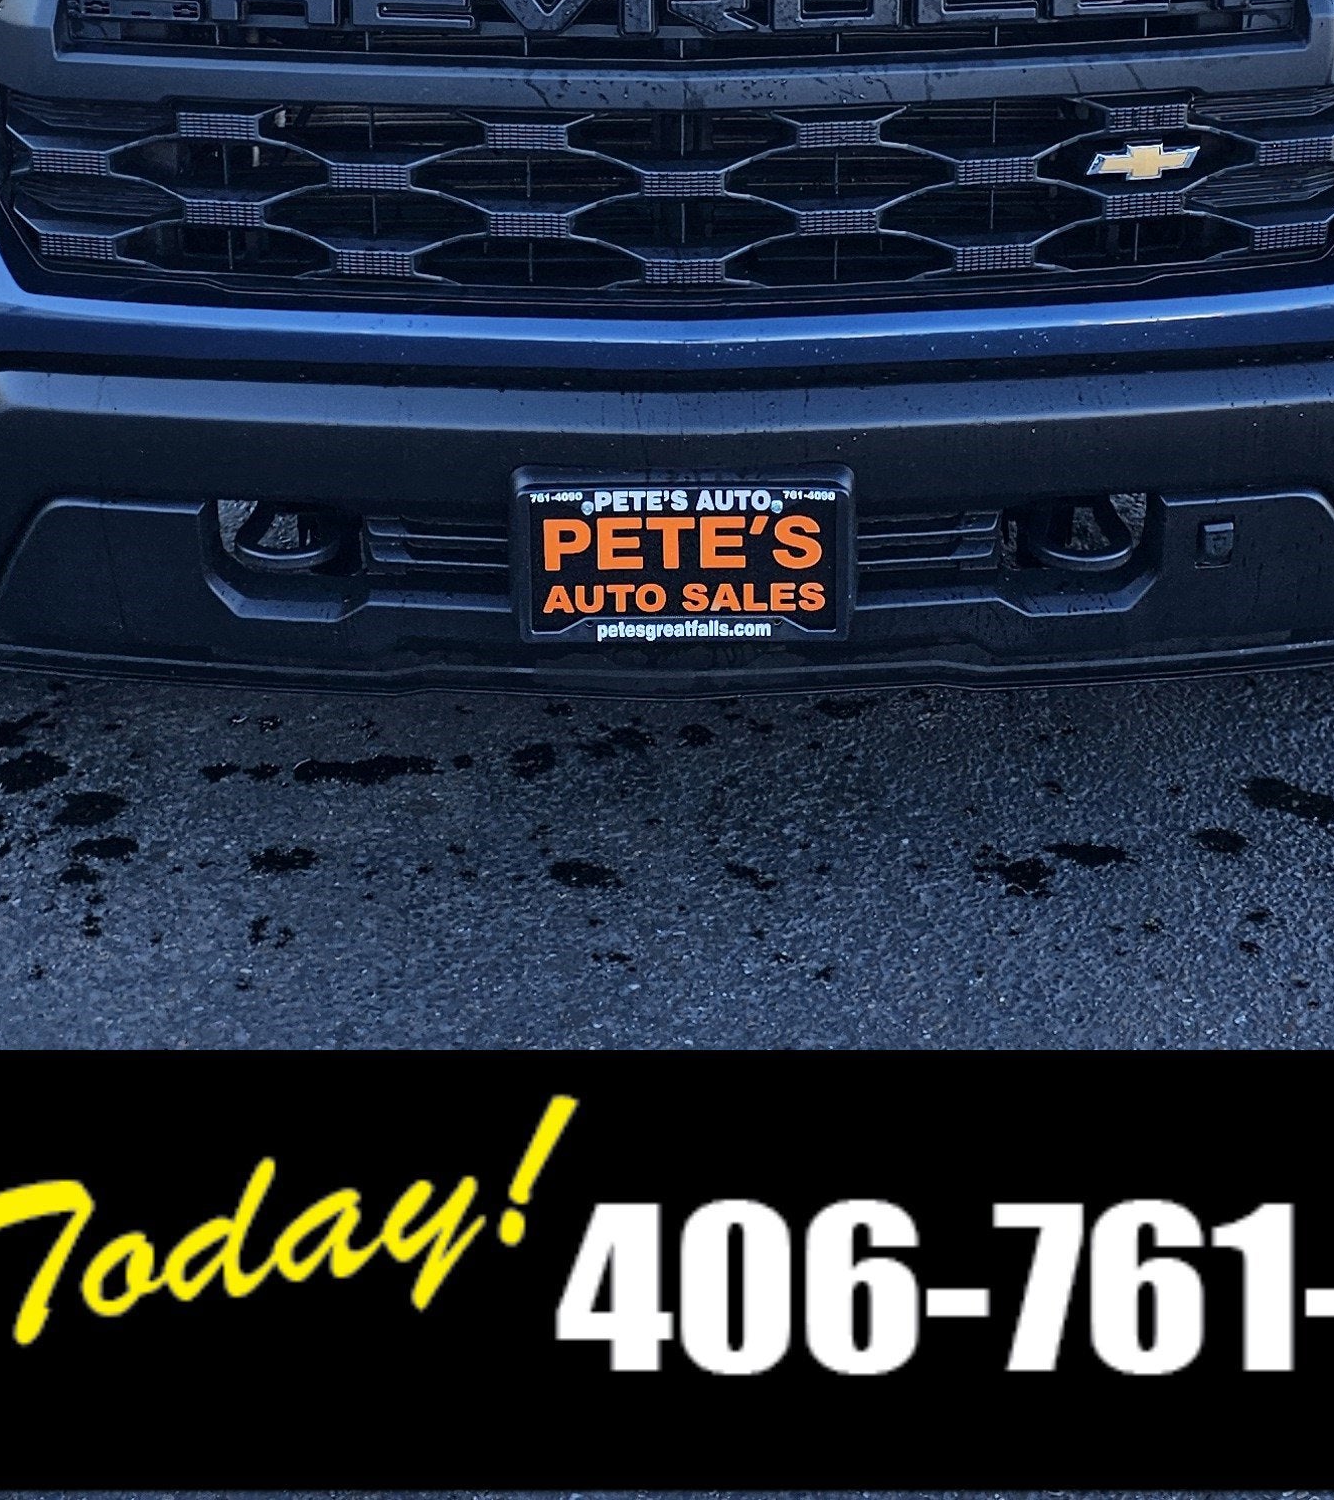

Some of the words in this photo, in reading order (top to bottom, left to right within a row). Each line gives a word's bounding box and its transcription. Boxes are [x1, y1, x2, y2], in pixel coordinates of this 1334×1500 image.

[594, 490, 689, 512] PETE'S
[695, 489, 772, 511] AUTO
[543, 515, 823, 572] PETE'S
[543, 583, 667, 614] AUTO
[682, 582, 826, 612] SALES
[596, 619, 772, 642] petesgreatfalls.com
